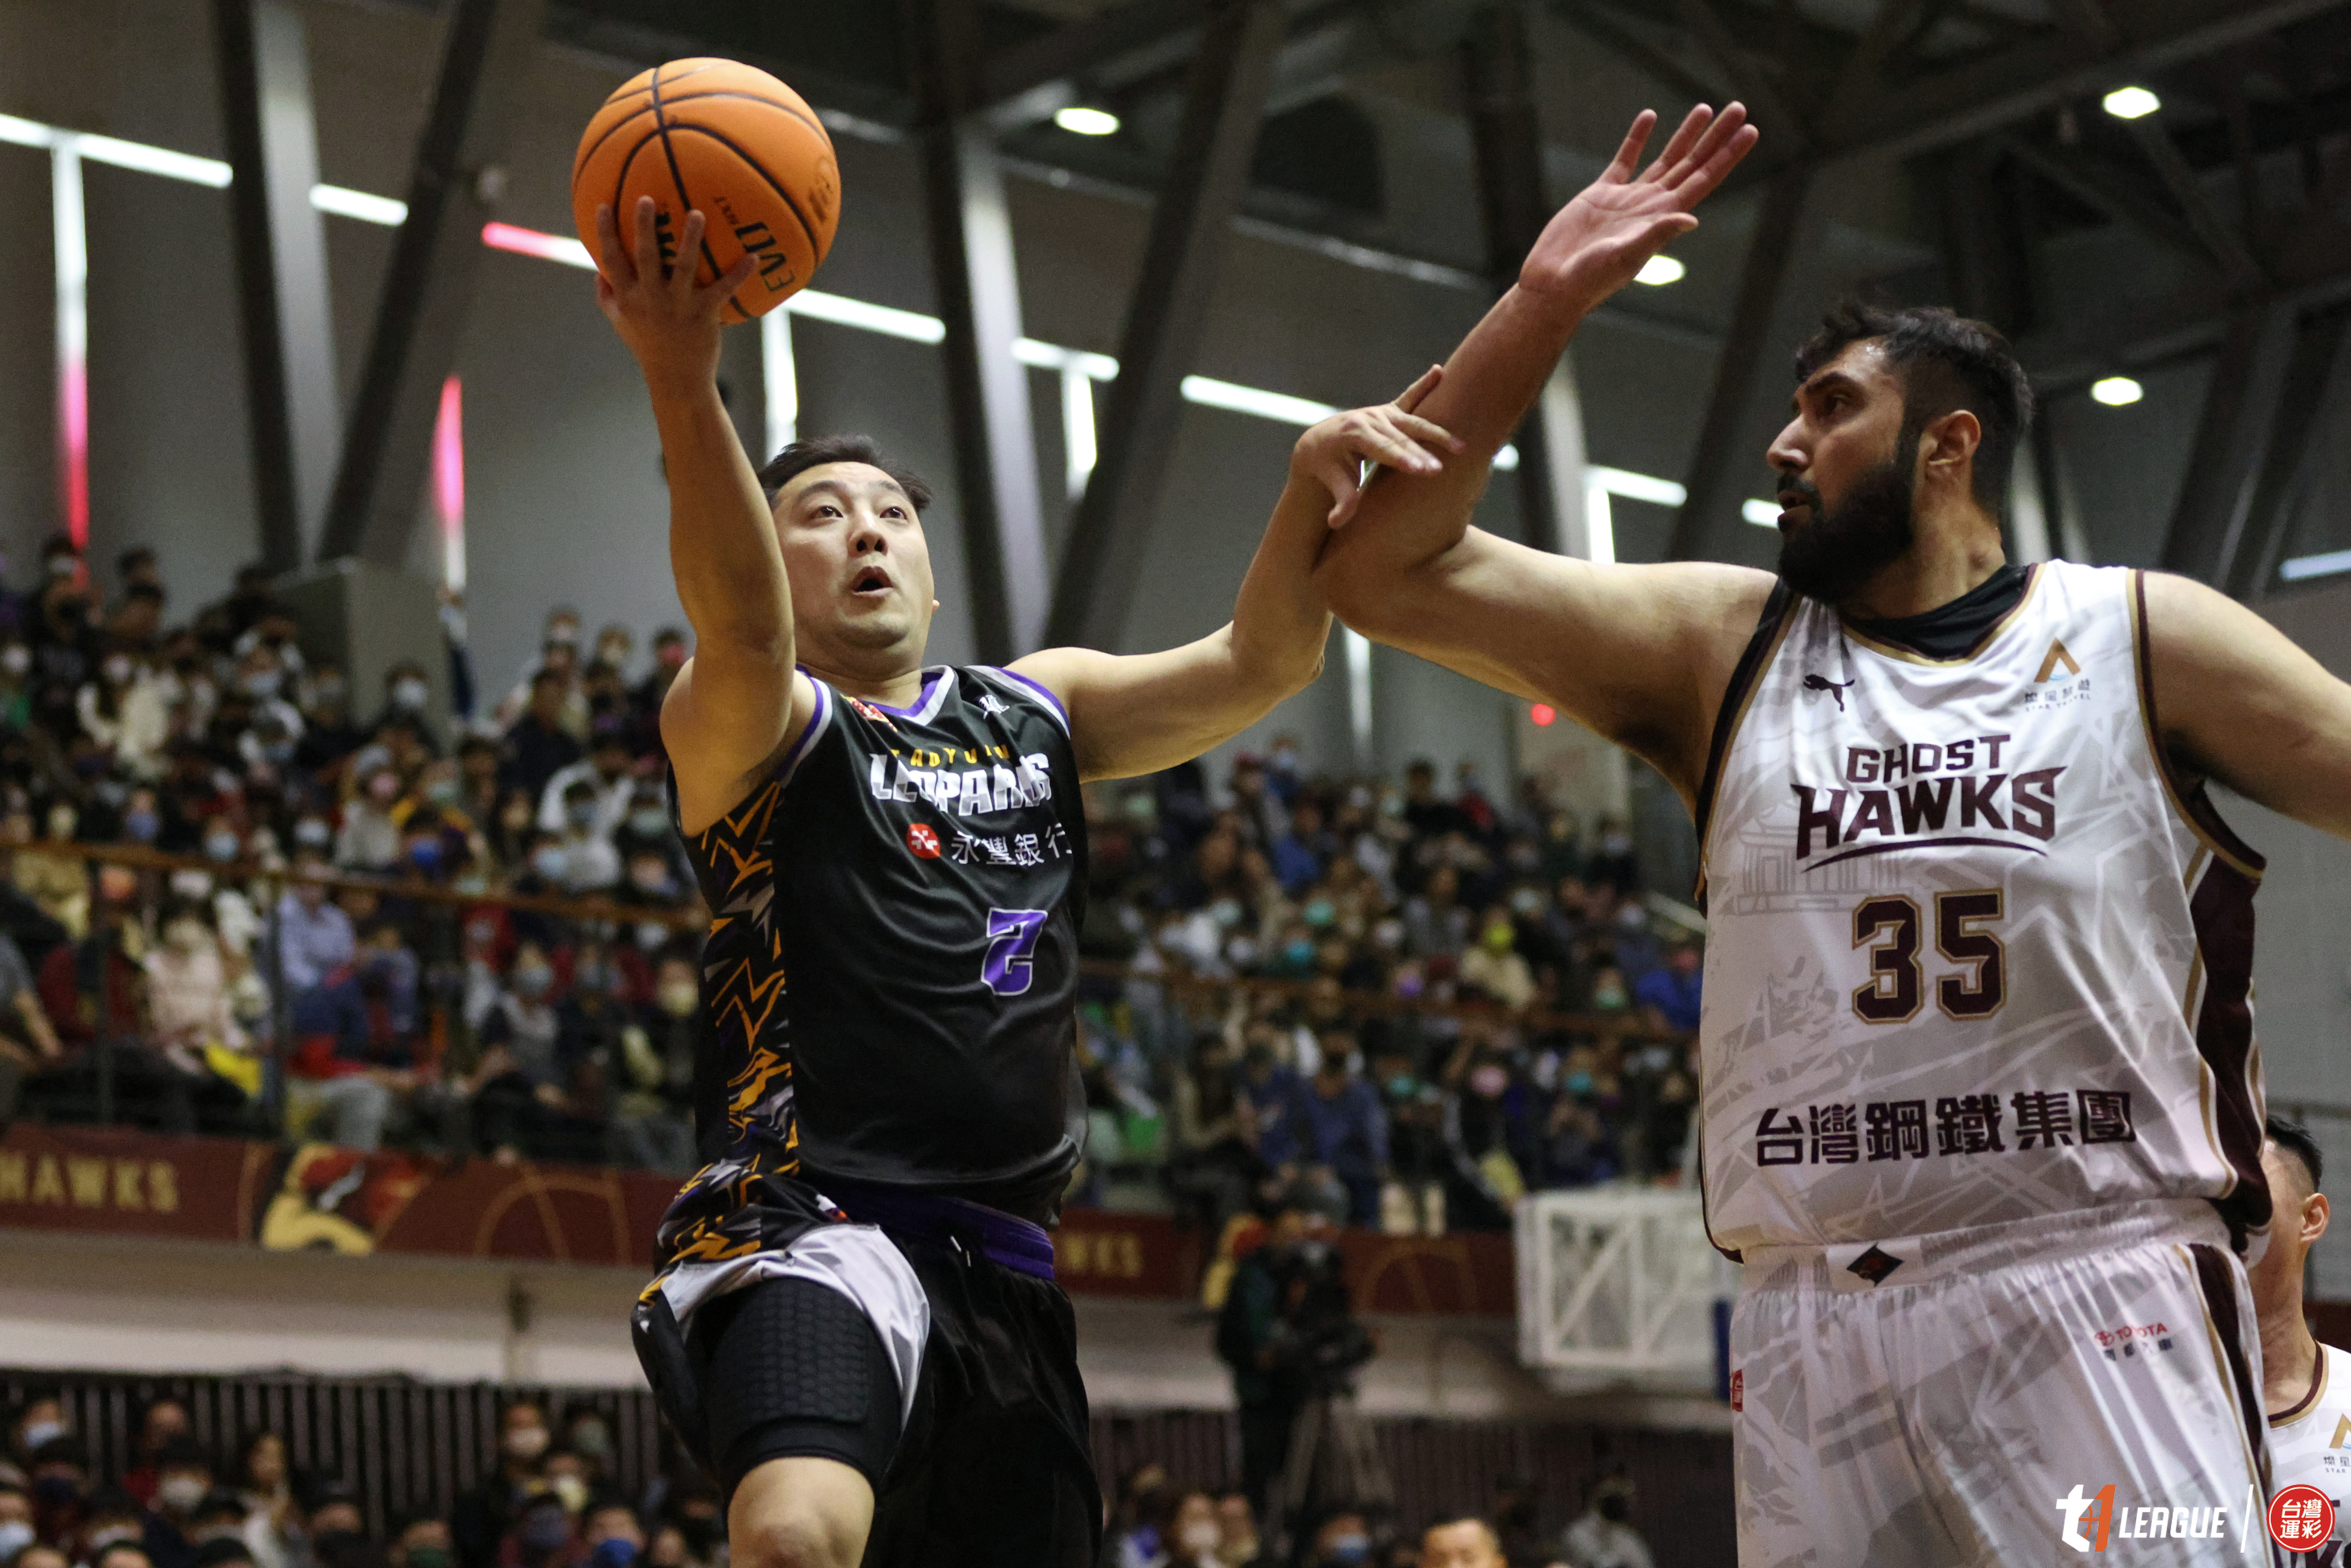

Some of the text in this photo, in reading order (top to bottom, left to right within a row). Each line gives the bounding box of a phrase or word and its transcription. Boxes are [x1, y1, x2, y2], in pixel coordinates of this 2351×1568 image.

[1846, 734, 2010, 783] GHOST
[1791, 766, 2068, 860] HAWKS
[980, 907, 1048, 996] 2
[1852, 887, 2007, 1024] 35
[1756, 1089, 2137, 1166] 台灣鋼鐵集團
[2116, 1322, 2168, 1341] TOOTA
